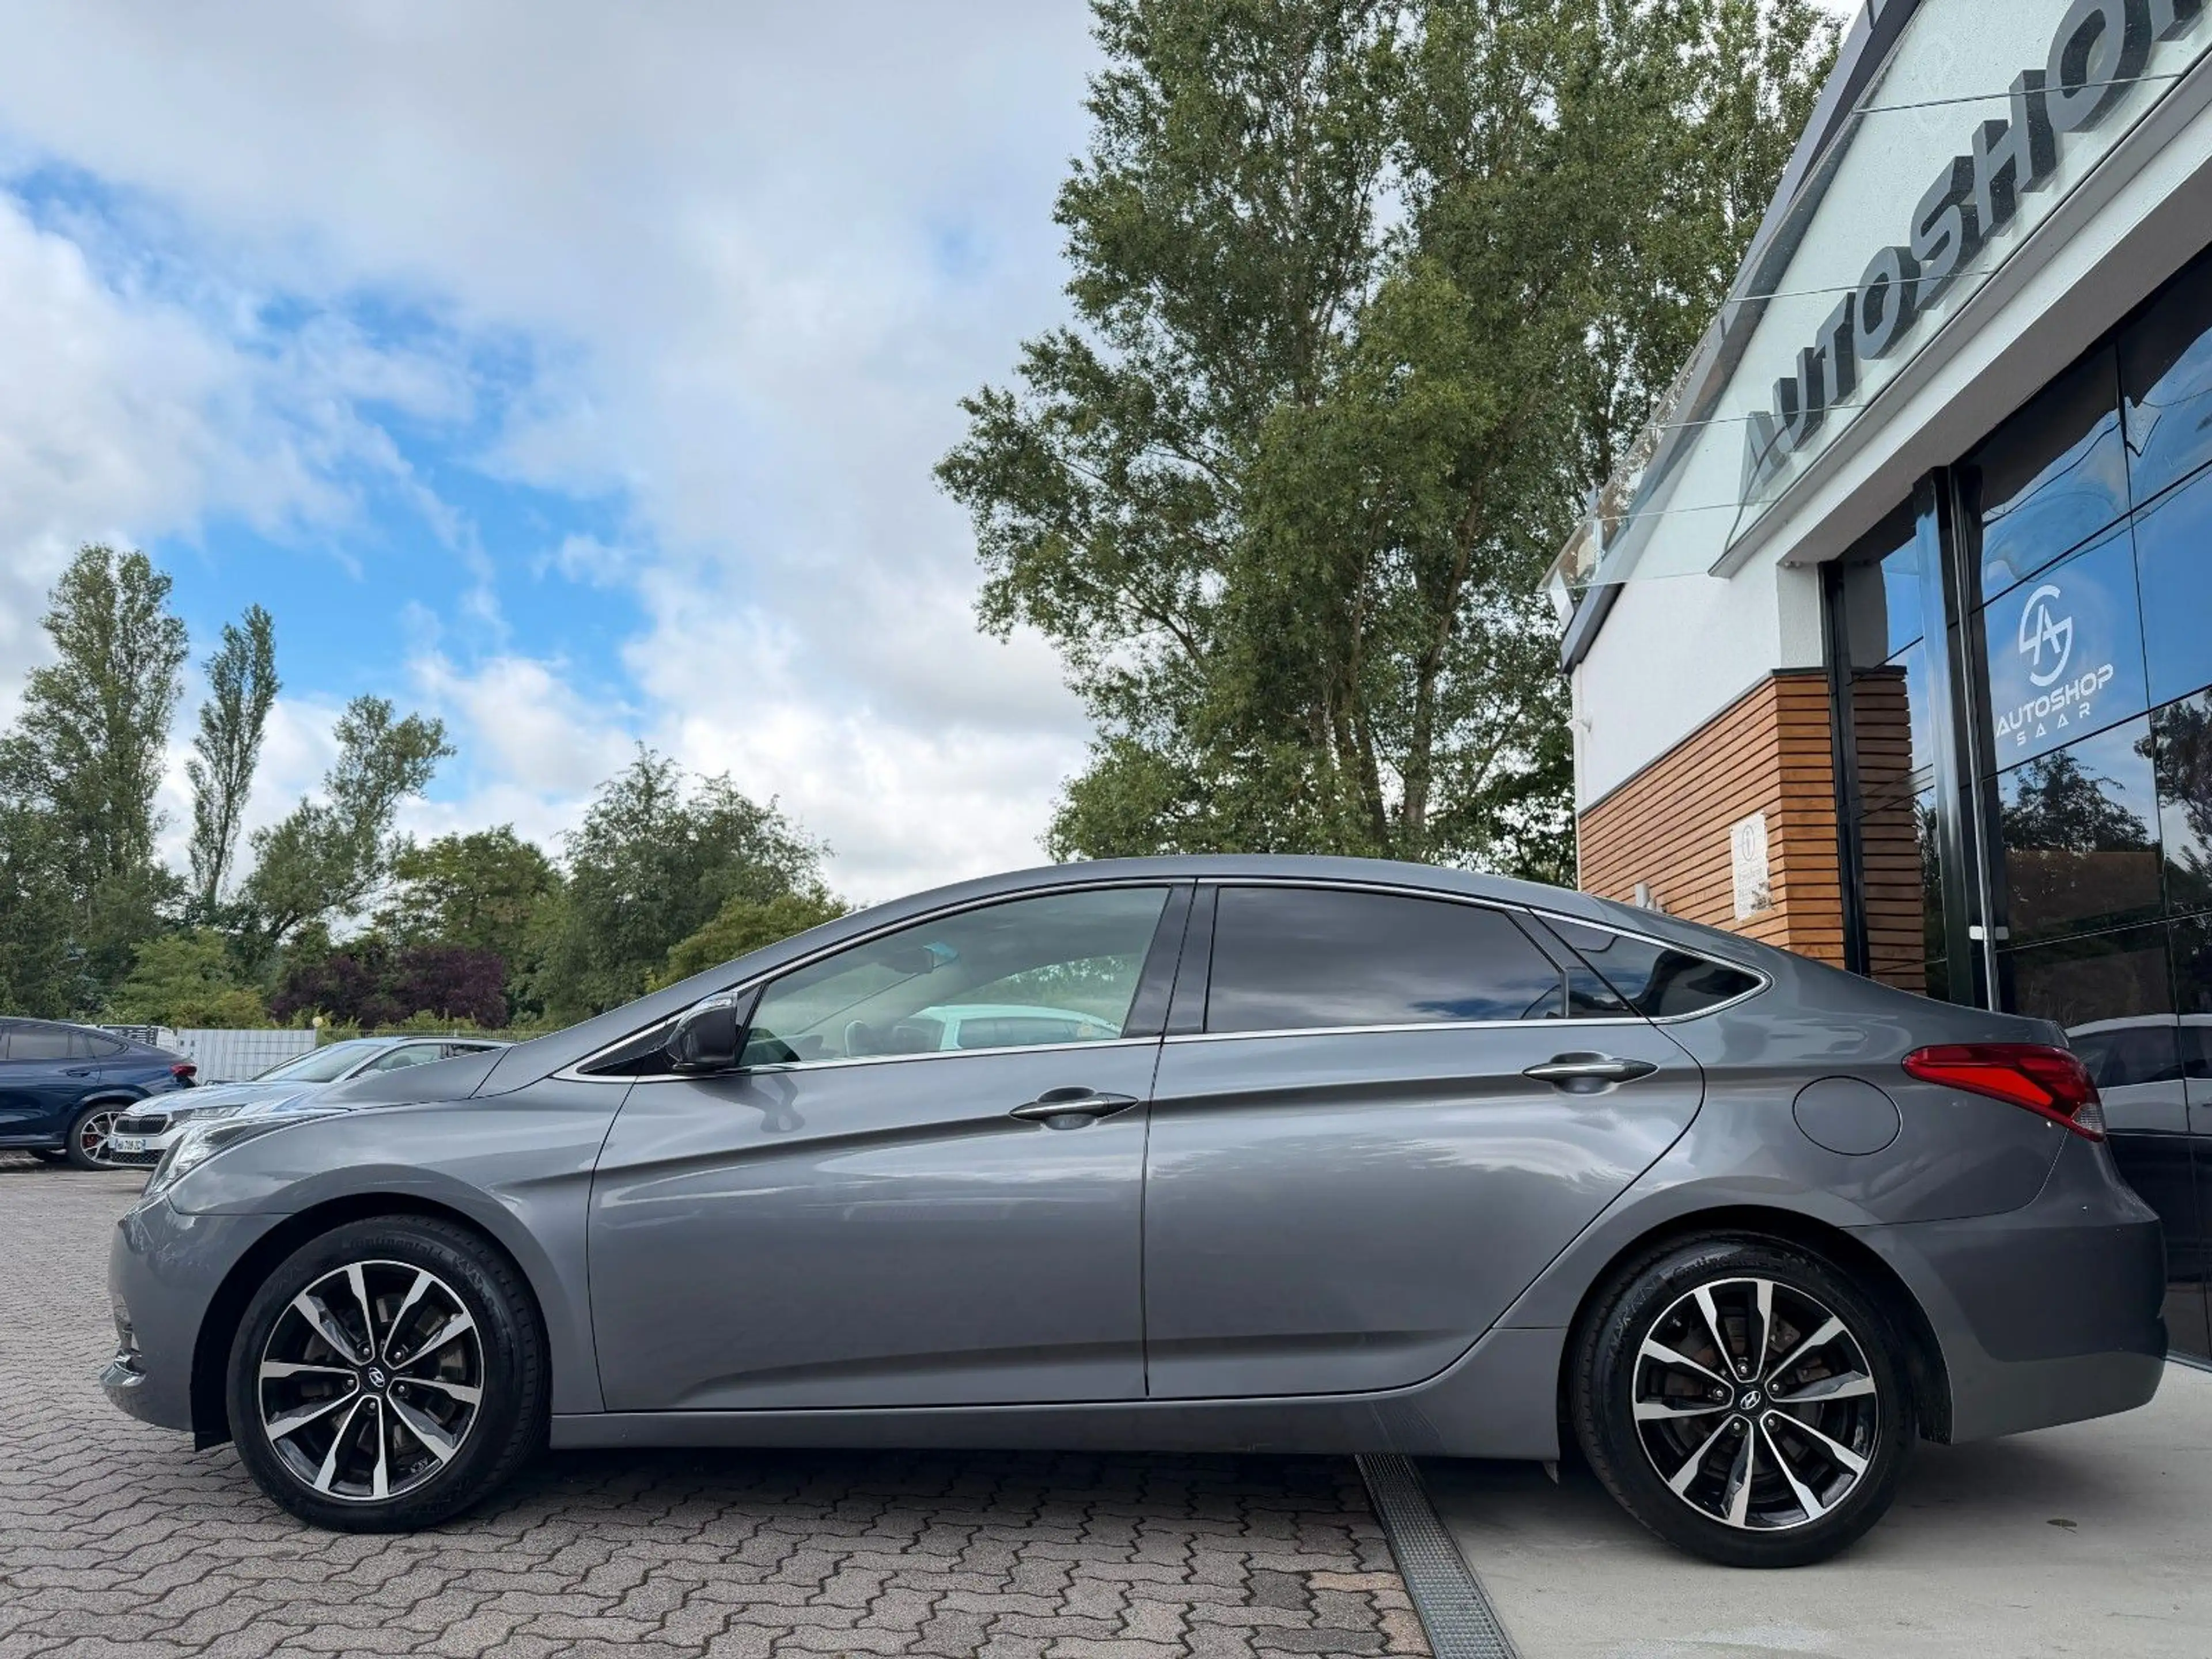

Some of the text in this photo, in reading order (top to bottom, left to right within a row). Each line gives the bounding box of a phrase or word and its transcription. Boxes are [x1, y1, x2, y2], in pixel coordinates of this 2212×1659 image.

[1738, 0, 2204, 506] AUTOSHO
[1997, 664, 2113, 737] AUTOSHOP
[2017, 702, 2090, 747] SAAR
